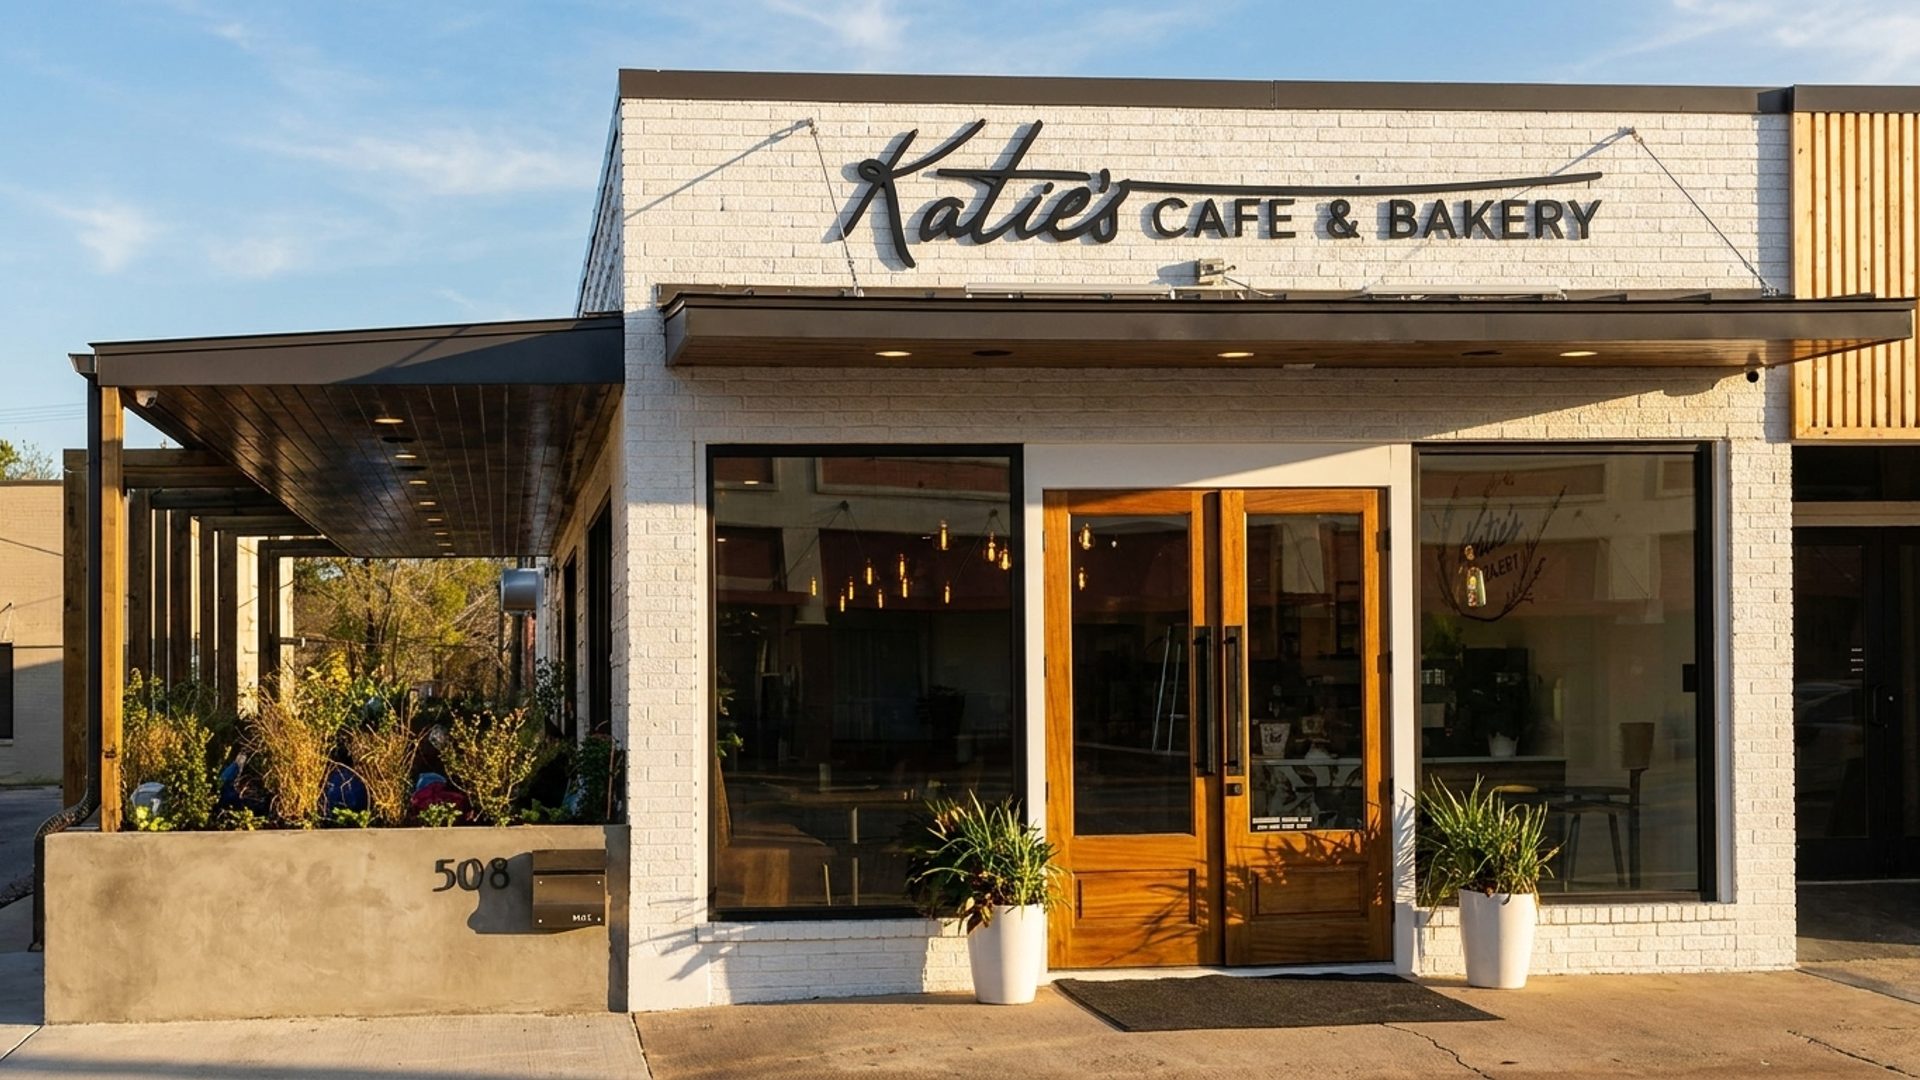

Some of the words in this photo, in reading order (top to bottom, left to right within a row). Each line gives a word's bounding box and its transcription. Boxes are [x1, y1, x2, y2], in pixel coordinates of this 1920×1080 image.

[838, 119, 1130, 268] Katie's
[1152, 198, 1297, 239] CAFE
[1326, 198, 1360, 239] &
[1388, 198, 1602, 240] BAKERY
[433, 857, 510, 892] 508
